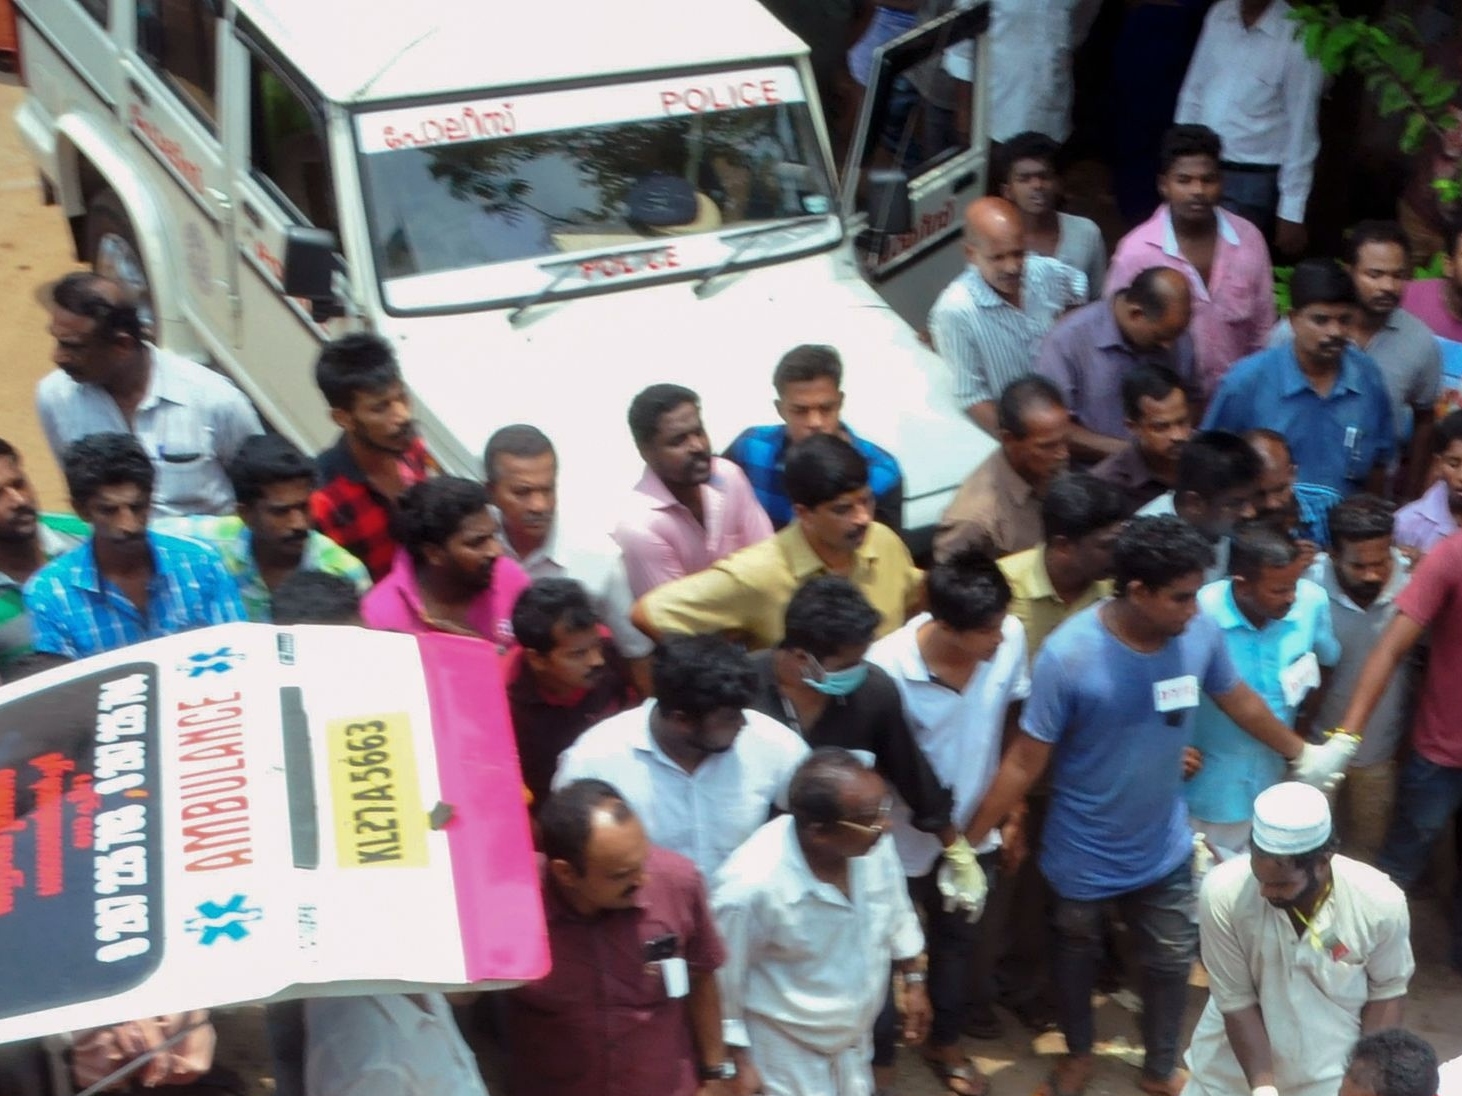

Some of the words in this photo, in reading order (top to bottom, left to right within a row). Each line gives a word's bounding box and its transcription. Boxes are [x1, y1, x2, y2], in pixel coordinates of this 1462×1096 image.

[660, 80, 782, 116] POLICE
[578, 245, 680, 280] POLICE
[177, 691, 254, 872] AMBULANCE
[347, 719, 402, 864] KL27A5663
